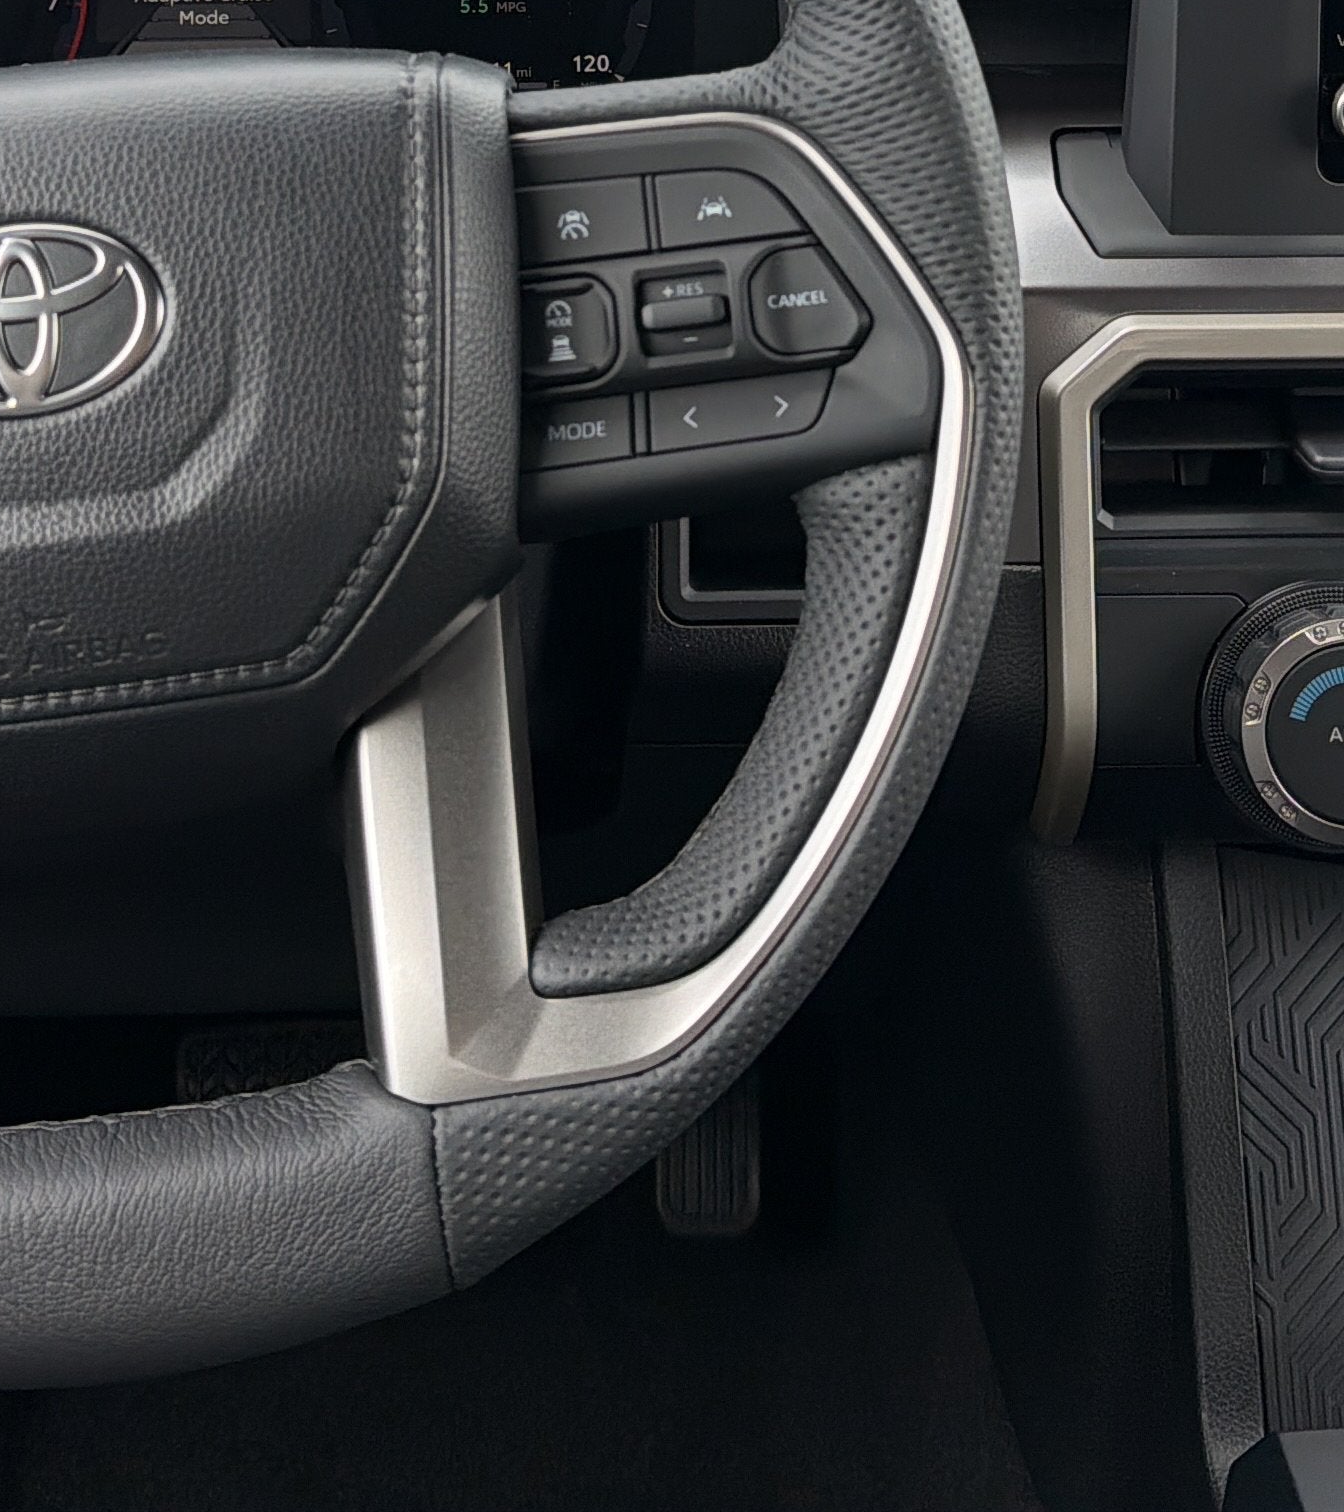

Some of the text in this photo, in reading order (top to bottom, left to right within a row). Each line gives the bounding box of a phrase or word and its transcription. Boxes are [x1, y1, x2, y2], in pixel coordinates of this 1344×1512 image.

[496, 0, 527, 15] MPG
[179, 10, 230, 25] Mode
[573, 55, 609, 73] 120
[516, 67, 532, 78] mi
[768, 291, 828, 310] CANCEL
[548, 420, 607, 441] MODE
